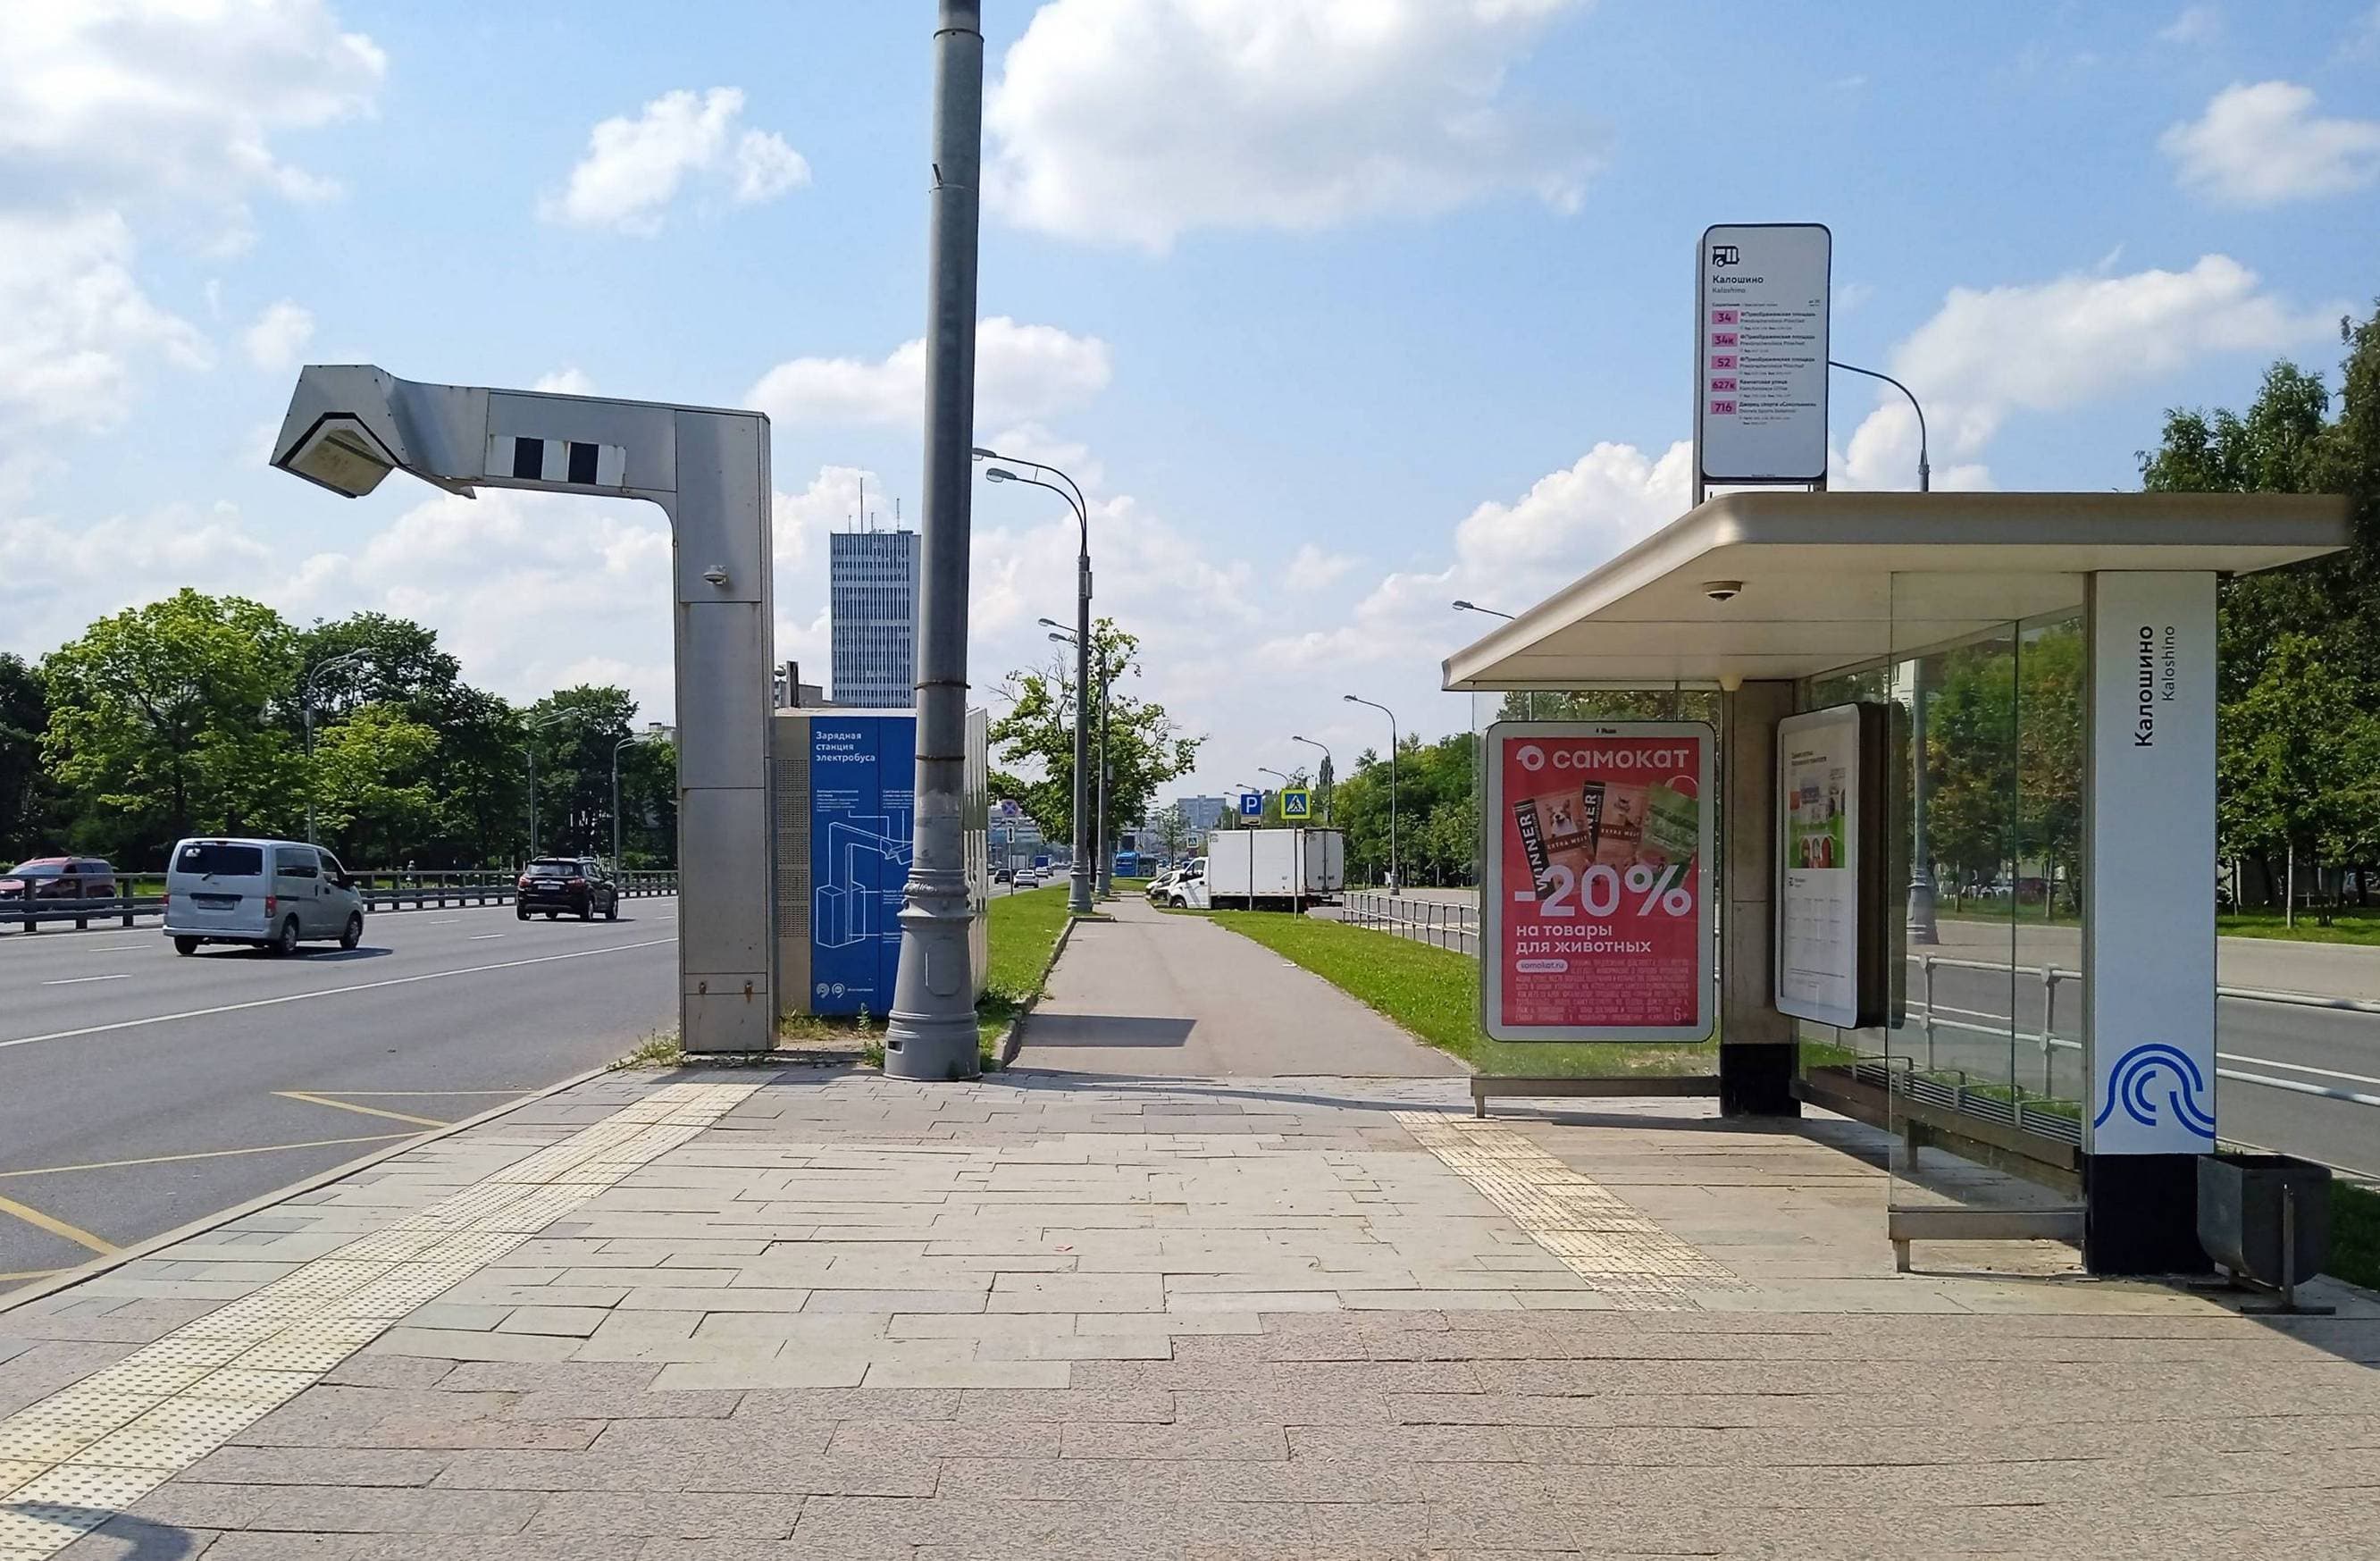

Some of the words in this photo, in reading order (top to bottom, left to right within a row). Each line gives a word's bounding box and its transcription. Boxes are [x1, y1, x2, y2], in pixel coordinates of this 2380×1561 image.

[1712, 274, 1764, 284] Калошино
[1717, 313, 1731, 323] 34
[1717, 357, 1731, 367] 52
[1714, 403, 1732, 412] 716
[2161, 625, 2175, 701] Kaloshino
[2134, 625, 2154, 747] Калошино
[816, 731, 862, 741] Зарядная
[816, 743, 854, 751] станция
[816, 753, 876, 763] электробуса
[1552, 748, 1689, 769] самокат
[1245, 796, 1258, 813] P
[1520, 813, 1551, 892] WINNER
[1514, 864, 1692, 918] -20%
[1516, 925, 1538, 936] на
[1544, 925, 1613, 940] товары
[1516, 941, 1550, 955] для
[1555, 941, 1652, 953] животных
[1521, 961, 1565, 969] samokat.ru
[1673, 1007, 1689, 1022] 6+
